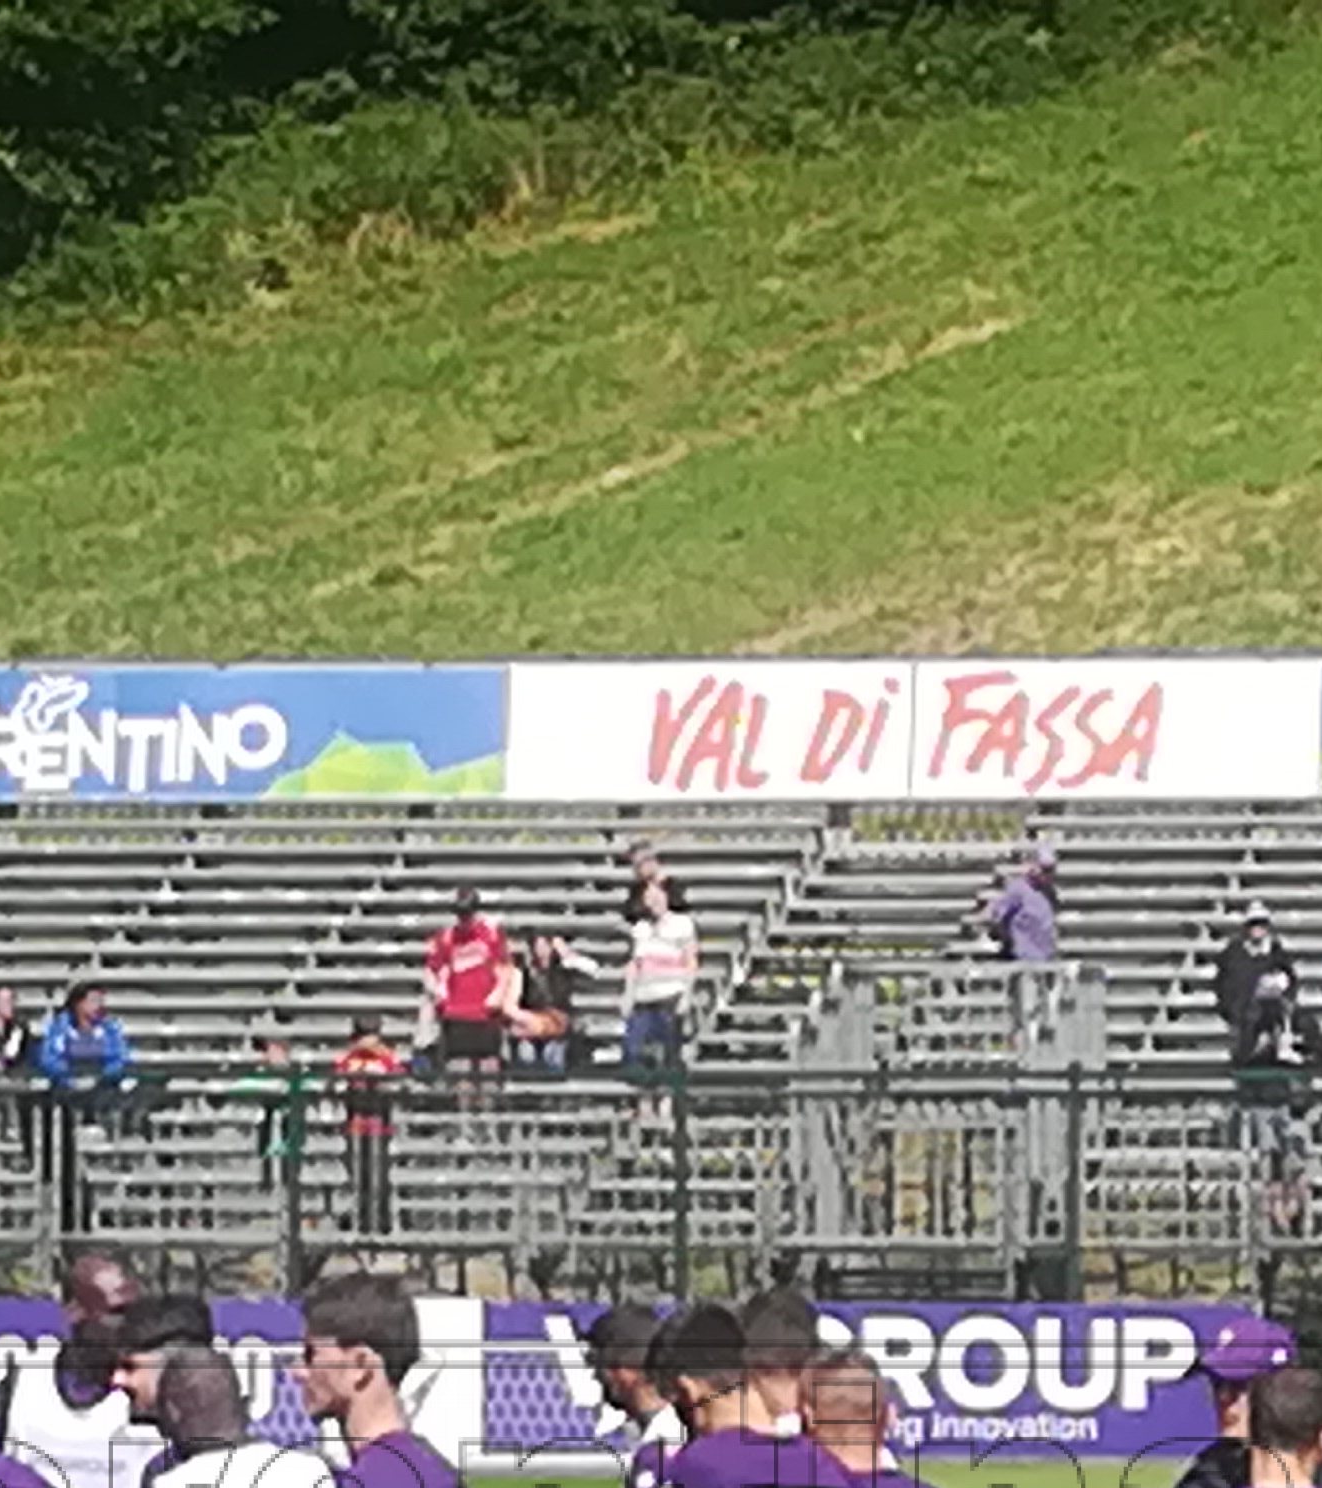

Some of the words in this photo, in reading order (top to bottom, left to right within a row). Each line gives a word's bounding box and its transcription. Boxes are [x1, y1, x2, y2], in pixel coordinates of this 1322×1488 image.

[646, 675, 769, 792] VAL
[927, 670, 1164, 794] FASSA
[930, 1409, 1099, 1442] innovation
